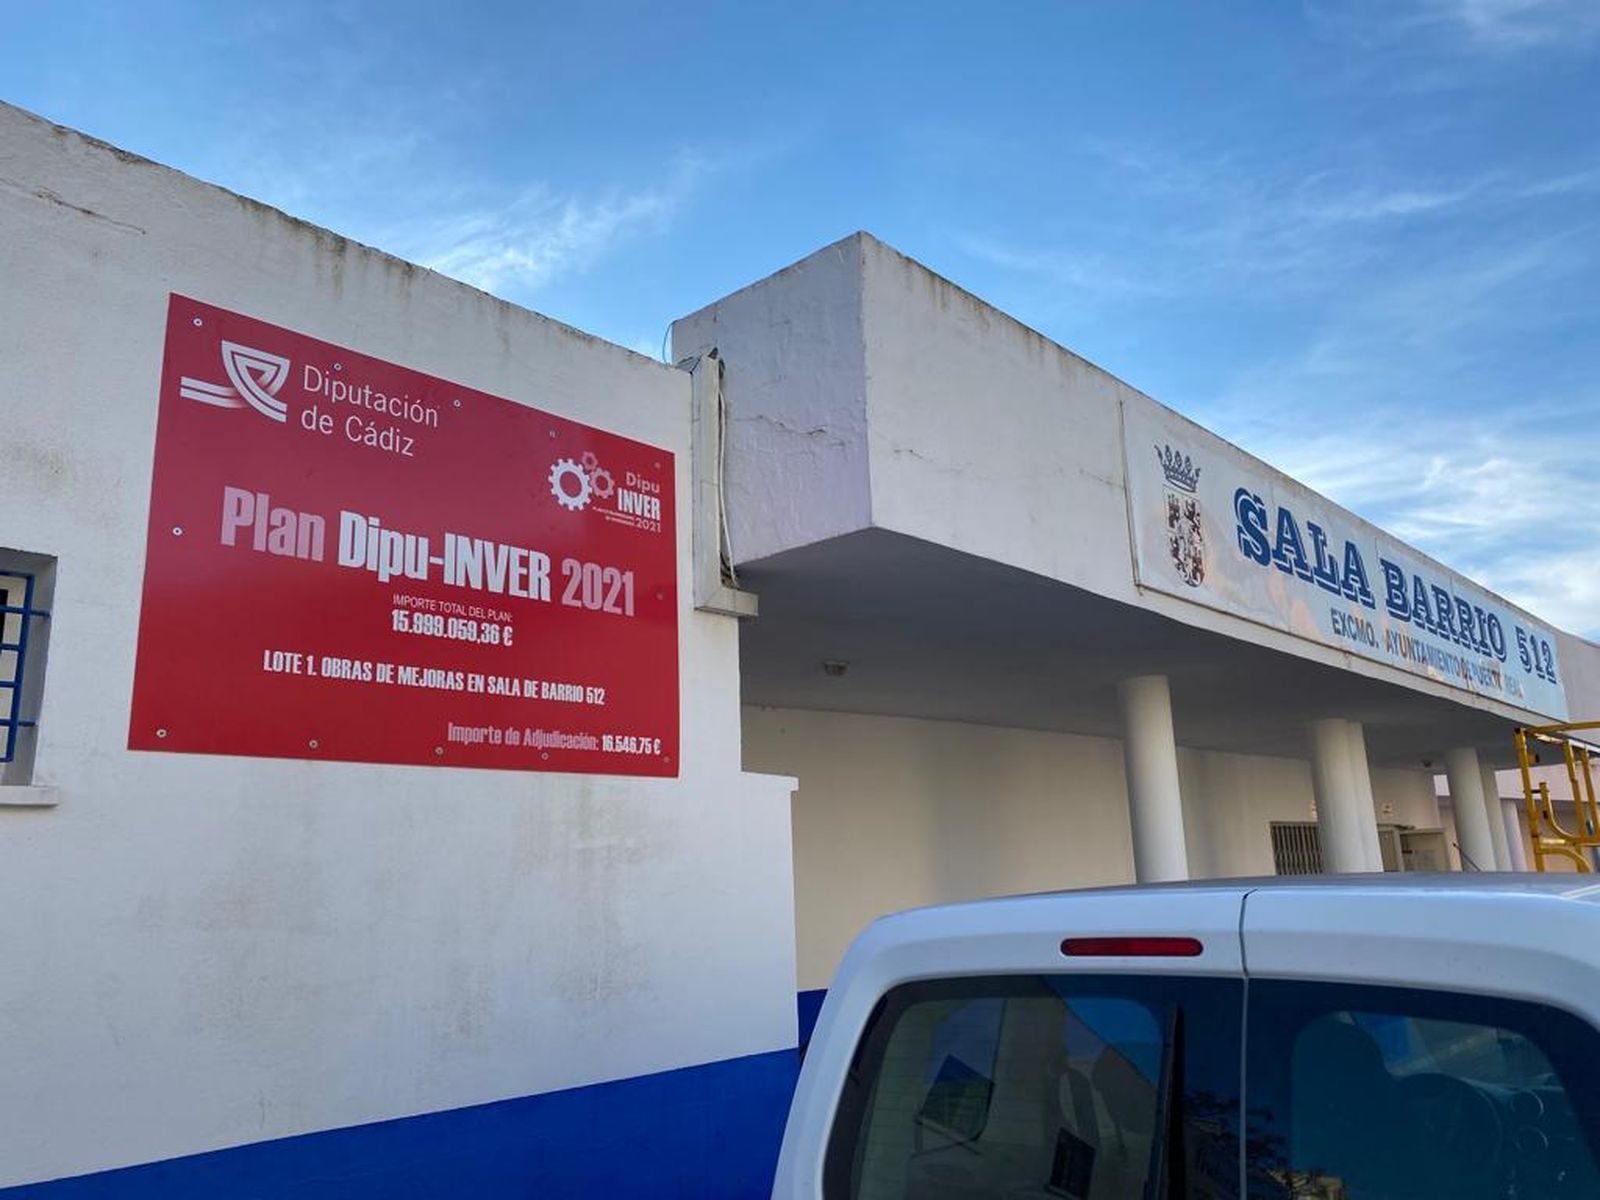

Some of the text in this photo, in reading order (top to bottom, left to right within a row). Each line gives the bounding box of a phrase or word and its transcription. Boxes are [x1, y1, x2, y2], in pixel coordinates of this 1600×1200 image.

[303, 364, 438, 428] Diputación
[301, 406, 414, 457] de Cádiz
[625, 471, 660, 494] Dipu
[617, 487, 661, 521] INVER
[635, 517, 661, 533] 2021
[220, 486, 635, 617] Plan Dipu-INVER 2021
[1234, 487, 1557, 685] SALA BARRIO 512
[392, 594, 436, 611] IMPORTE
[438, 601, 467, 617] TOTAL
[468, 605, 486, 619] DEL
[502, 626, 513, 646] €
[1330, 607, 1380, 649] EXCMO.
[263, 650, 605, 705] LOTE 1. OBRAS DE MEJORAS EN SALA DE BARRIO 512
[448, 722, 502, 745] Importe
[504, 727, 520, 745] de
[653, 738, 661, 755] €
